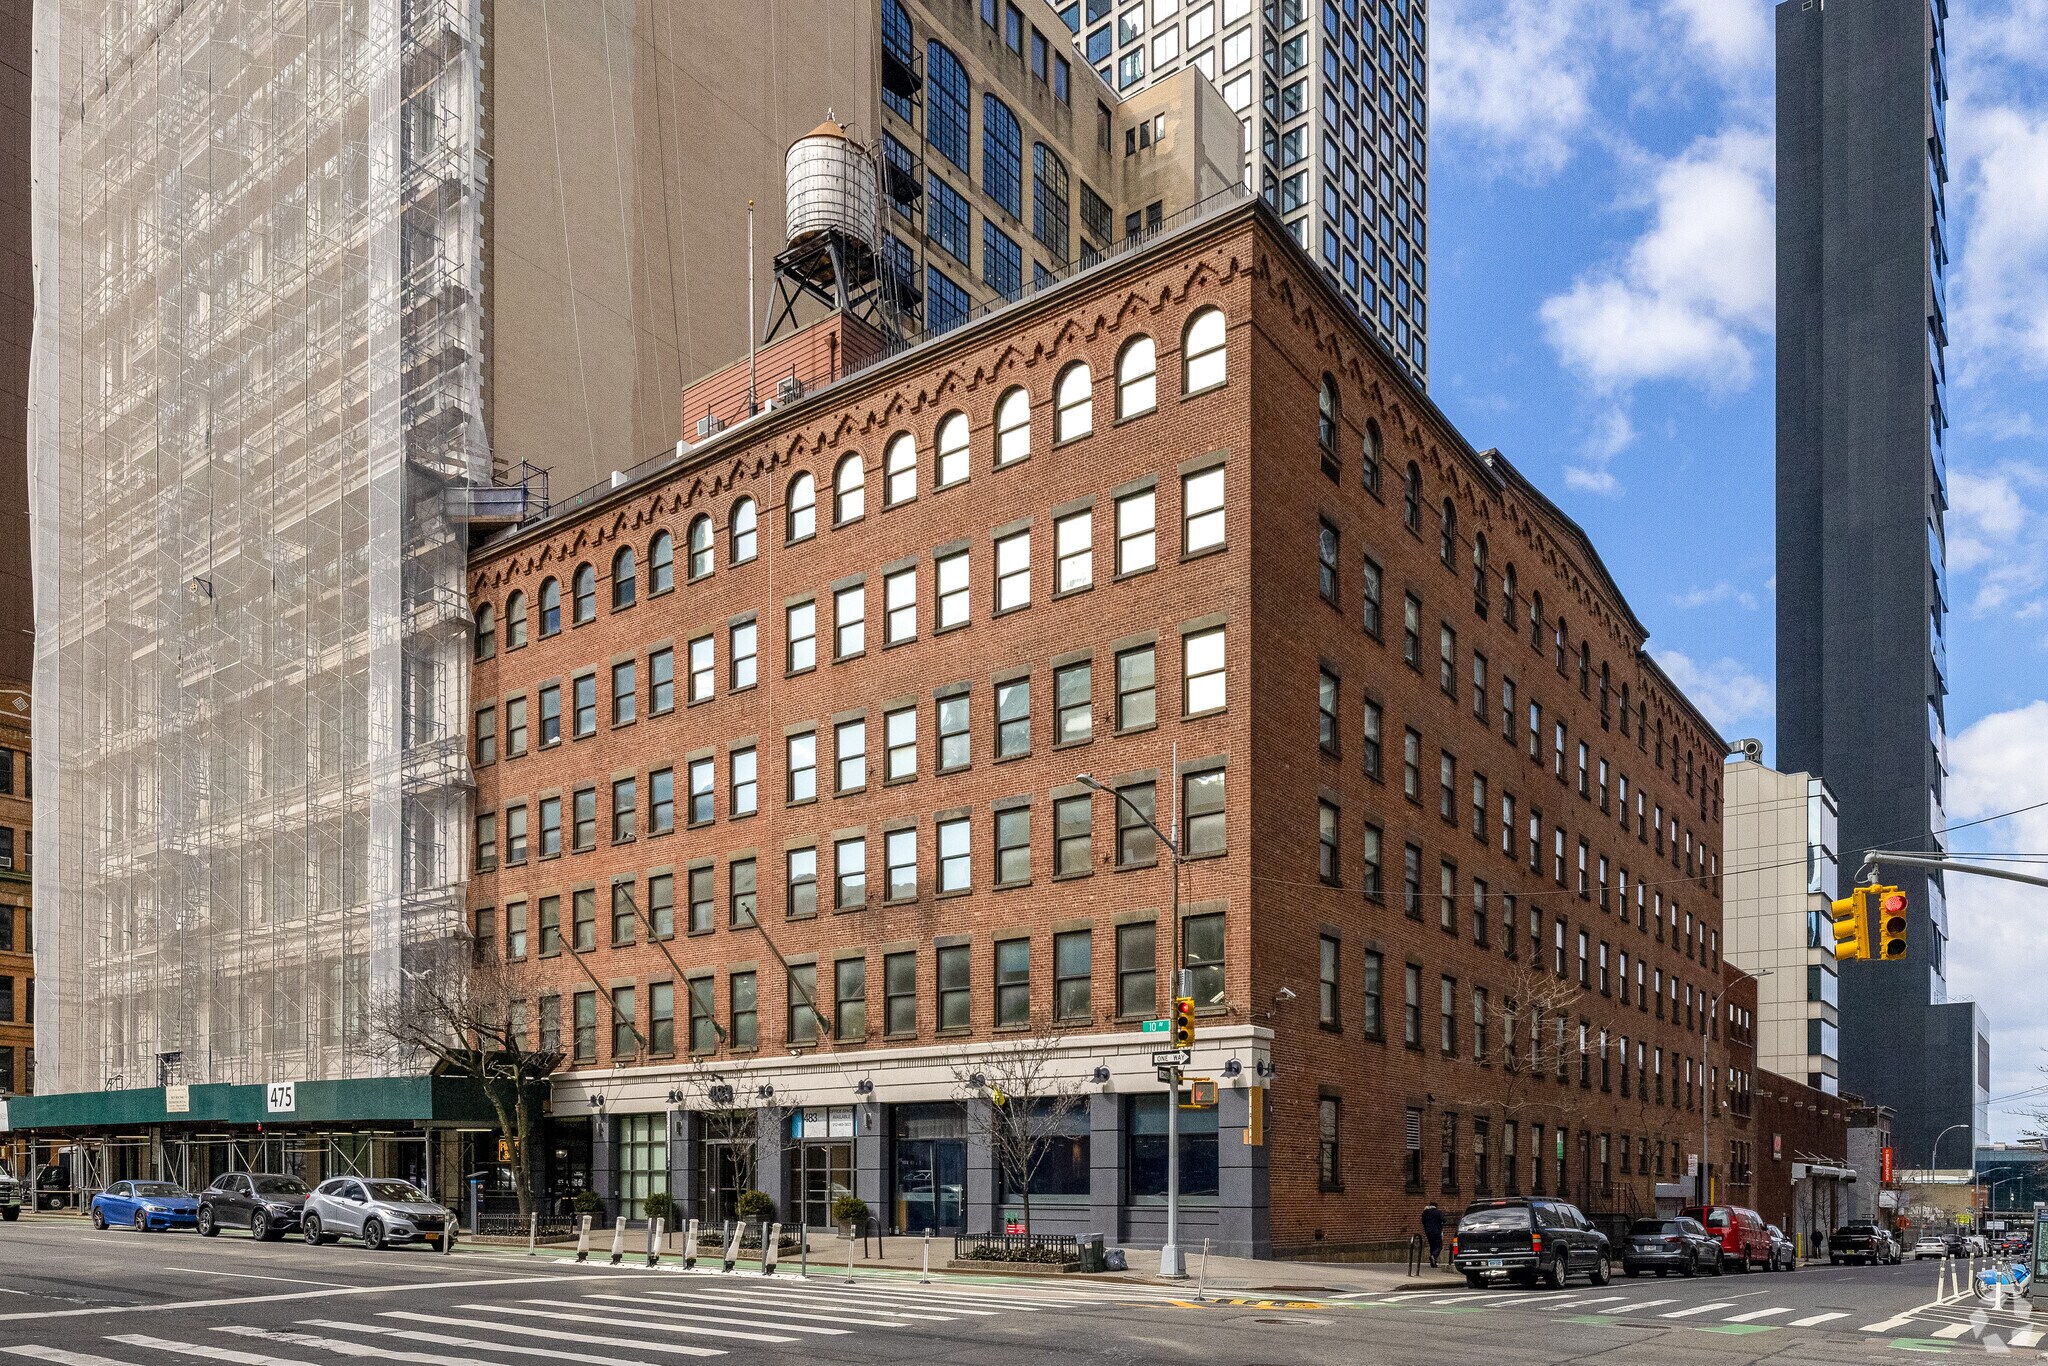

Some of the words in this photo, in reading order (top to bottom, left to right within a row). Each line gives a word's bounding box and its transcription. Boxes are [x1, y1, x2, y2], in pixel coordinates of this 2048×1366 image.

[1149, 1022, 1156, 1031] 10
[270, 1086, 292, 1107] 475
[803, 1112, 818, 1122] 483
